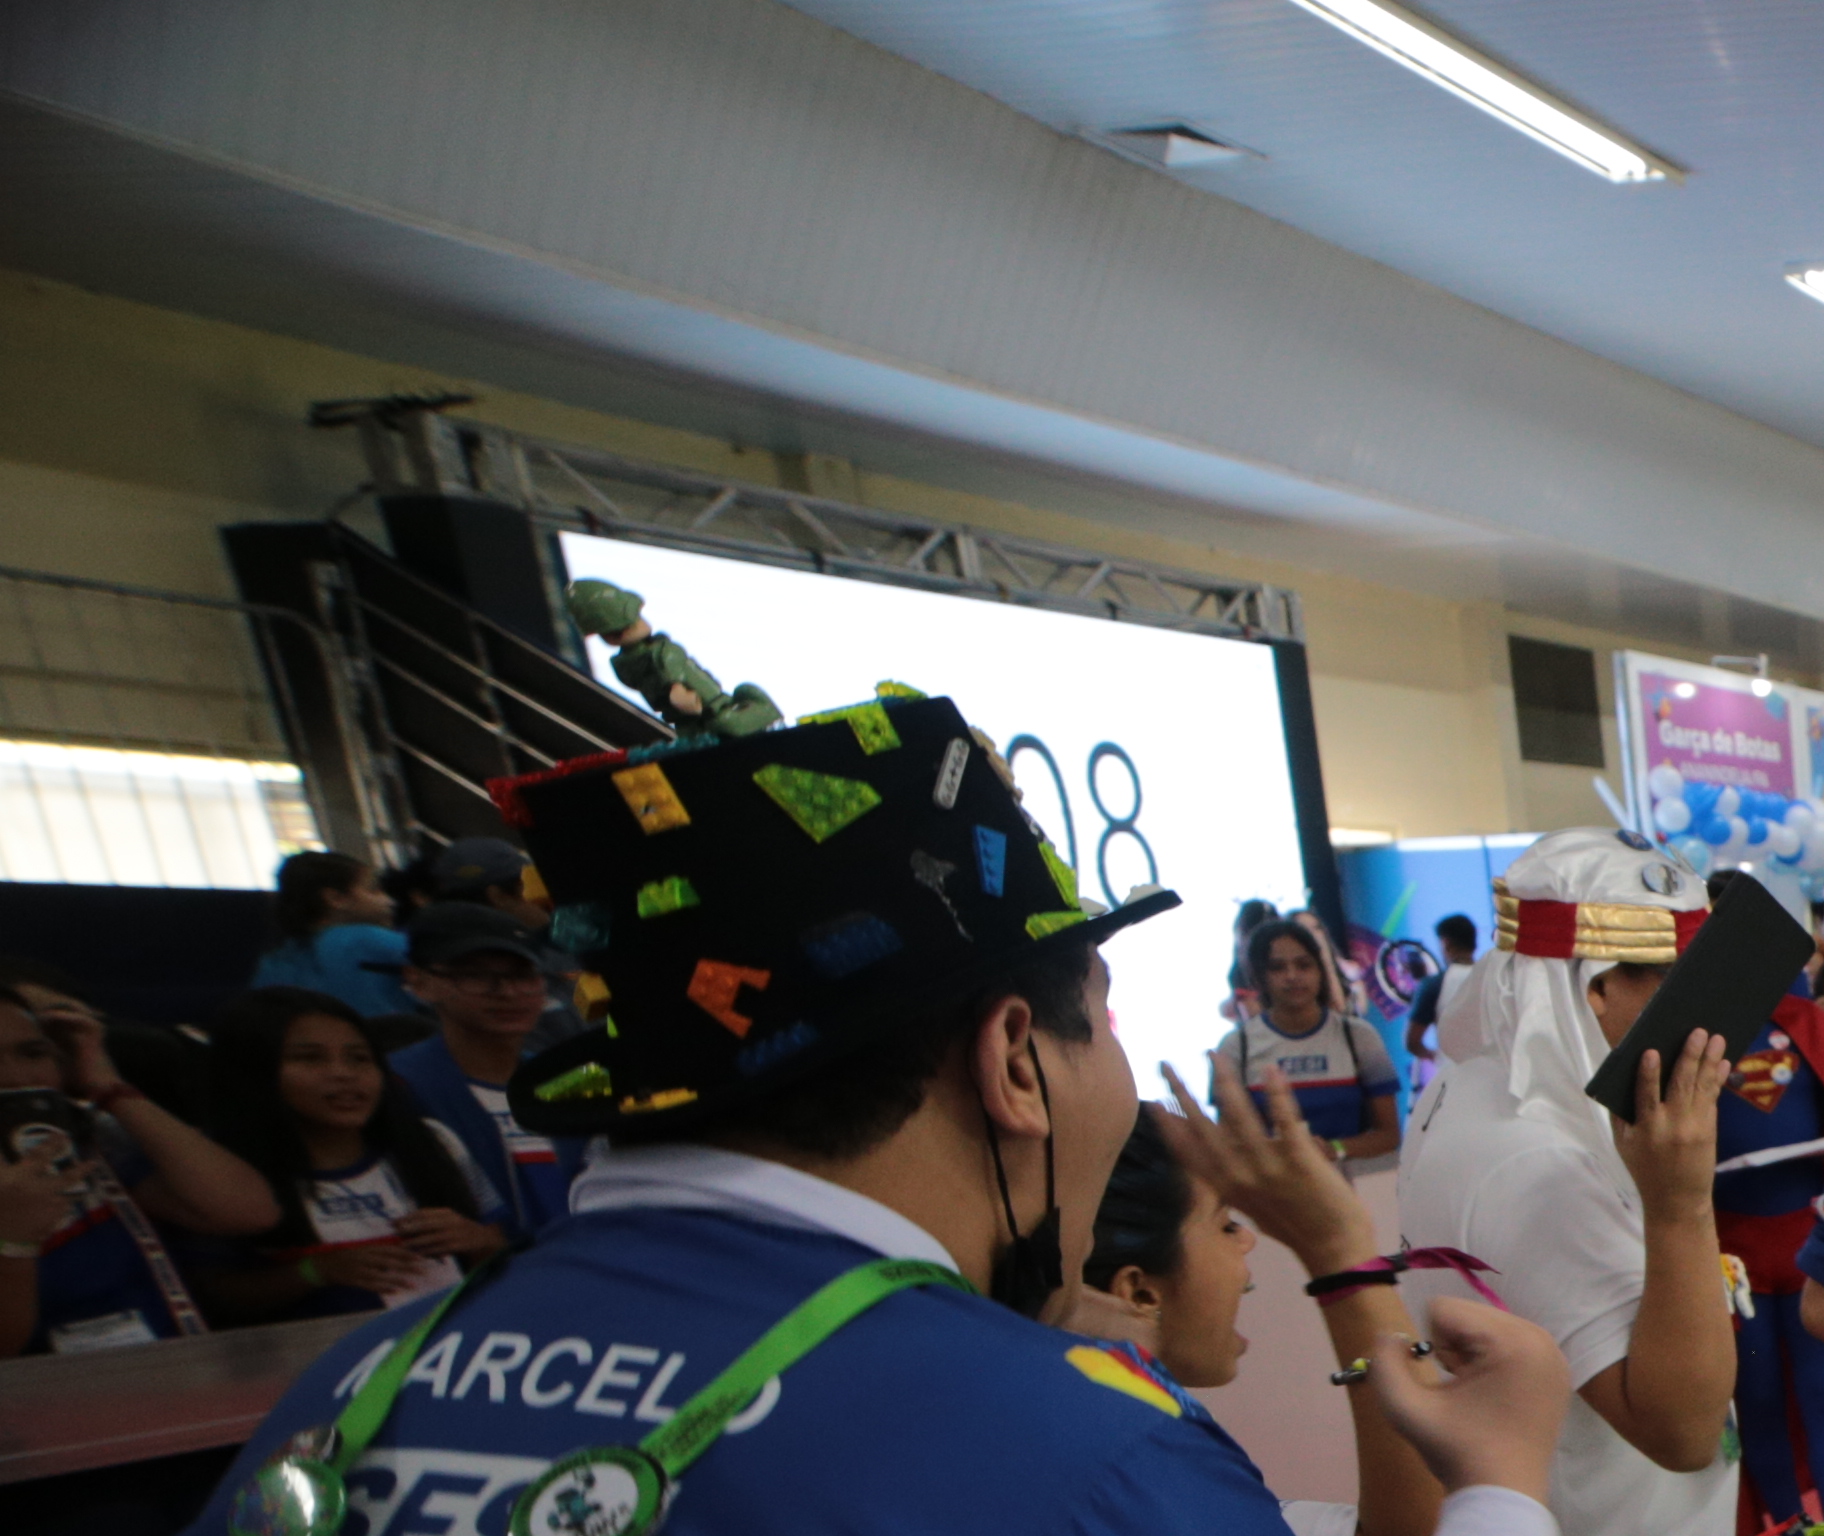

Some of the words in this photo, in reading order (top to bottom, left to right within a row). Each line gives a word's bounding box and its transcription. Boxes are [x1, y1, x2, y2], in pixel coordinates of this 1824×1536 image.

[1658, 718, 1712, 758] Garça
[1712, 727, 1734, 755] de
[1734, 732, 1782, 762] Botas
